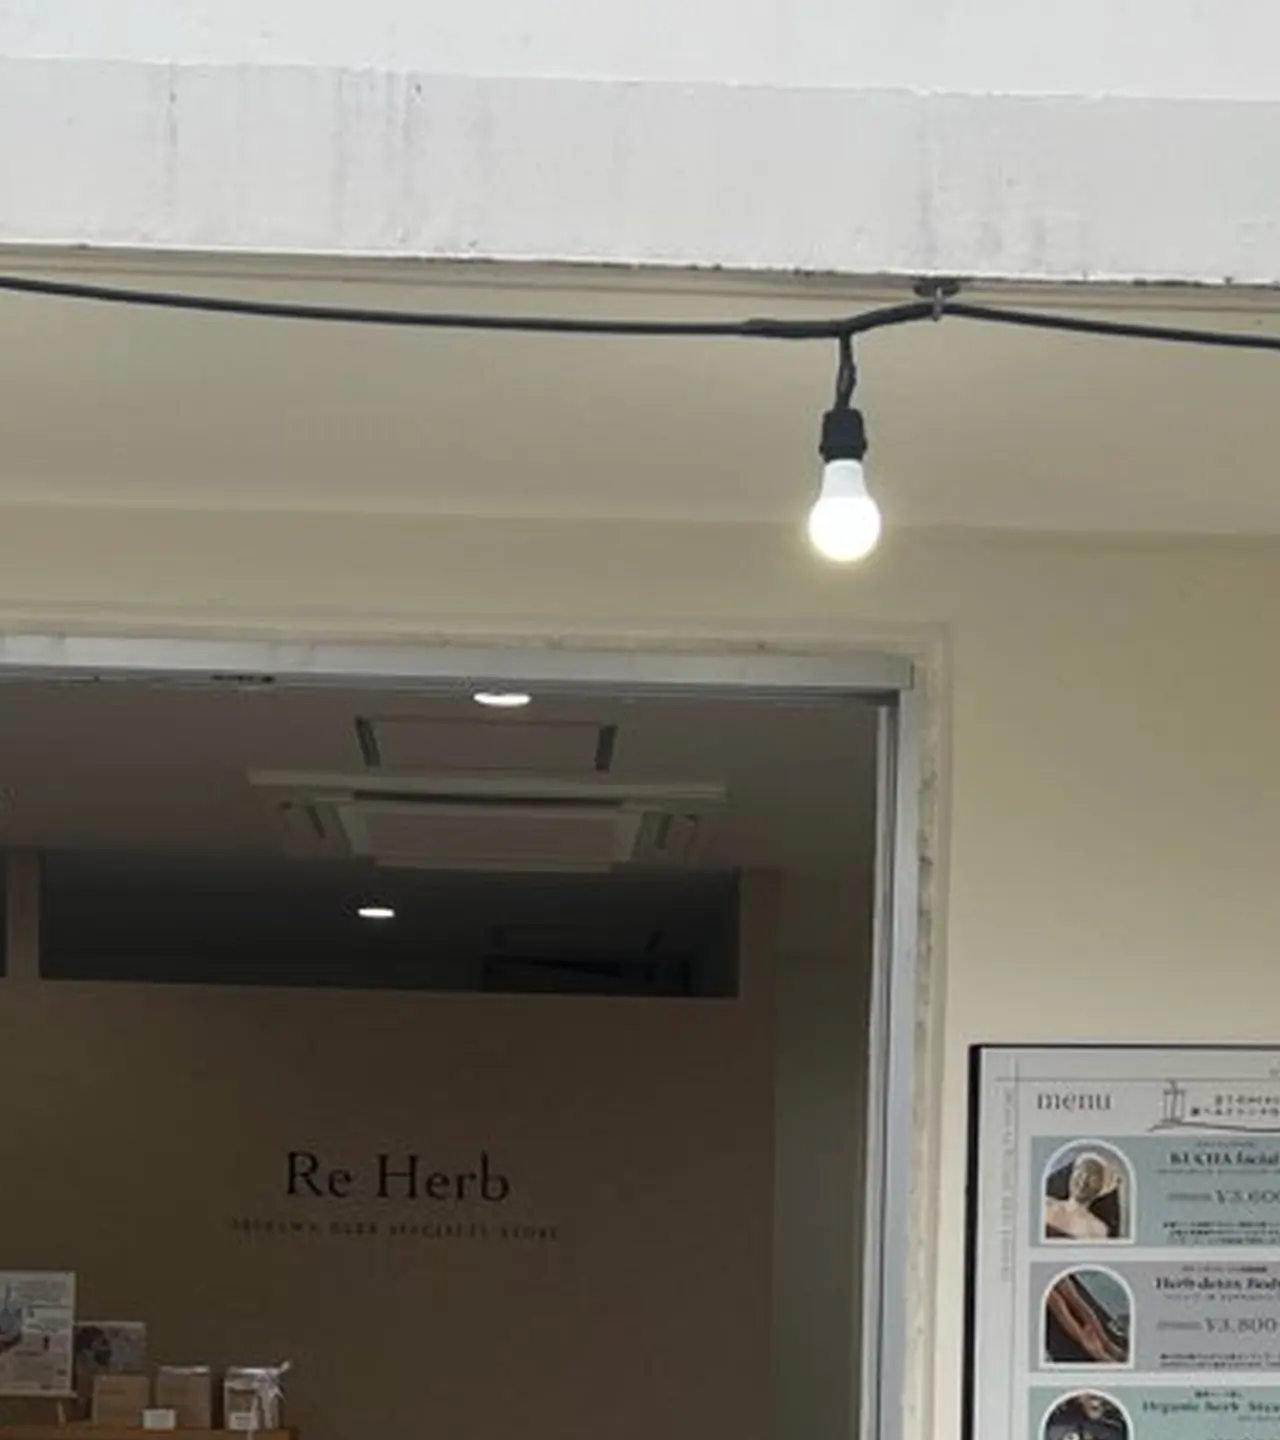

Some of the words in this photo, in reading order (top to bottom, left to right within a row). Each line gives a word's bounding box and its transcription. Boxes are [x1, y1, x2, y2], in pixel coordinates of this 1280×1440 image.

[1037, 1091, 1112, 1111] menu
[286, 1151, 353, 1199] Re
[376, 1150, 510, 1201] Herb
